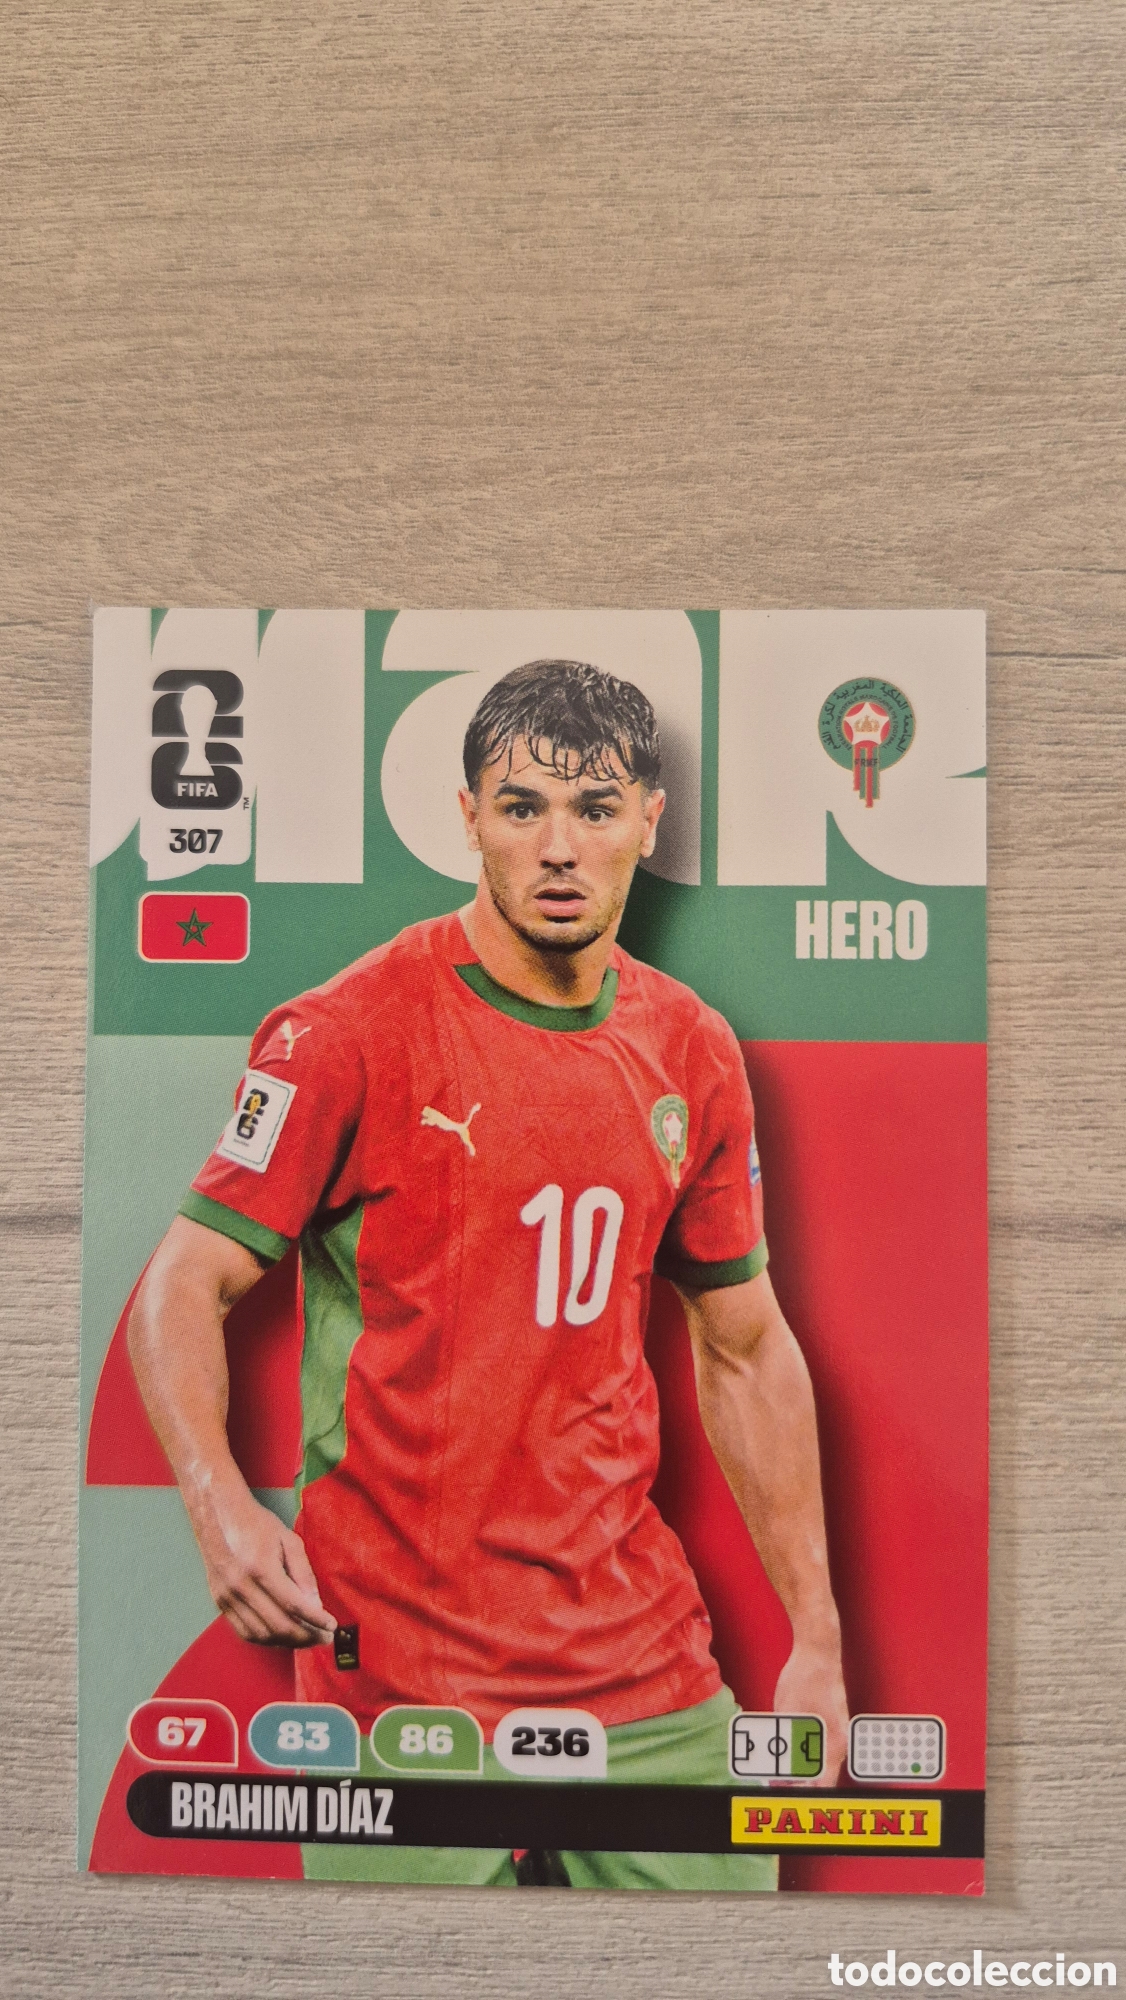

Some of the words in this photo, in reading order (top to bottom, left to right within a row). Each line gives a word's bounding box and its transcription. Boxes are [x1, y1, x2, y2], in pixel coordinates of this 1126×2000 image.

[833, 679, 875, 700] المغربية
[176, 782, 219, 797] FIFA
[169, 828, 224, 854] 307
[795, 900, 929, 961] HERO
[520, 1183, 624, 1328] 10
[157, 1716, 207, 1747] 67
[277, 1720, 331, 1752] 83
[400, 1723, 454, 1754] 86
[511, 1726, 590, 1757] 236
[171, 1781, 308, 1833] BRAHIM
[316, 1779, 394, 1835] DÍAZ
[744, 1807, 929, 1836] PANINI
